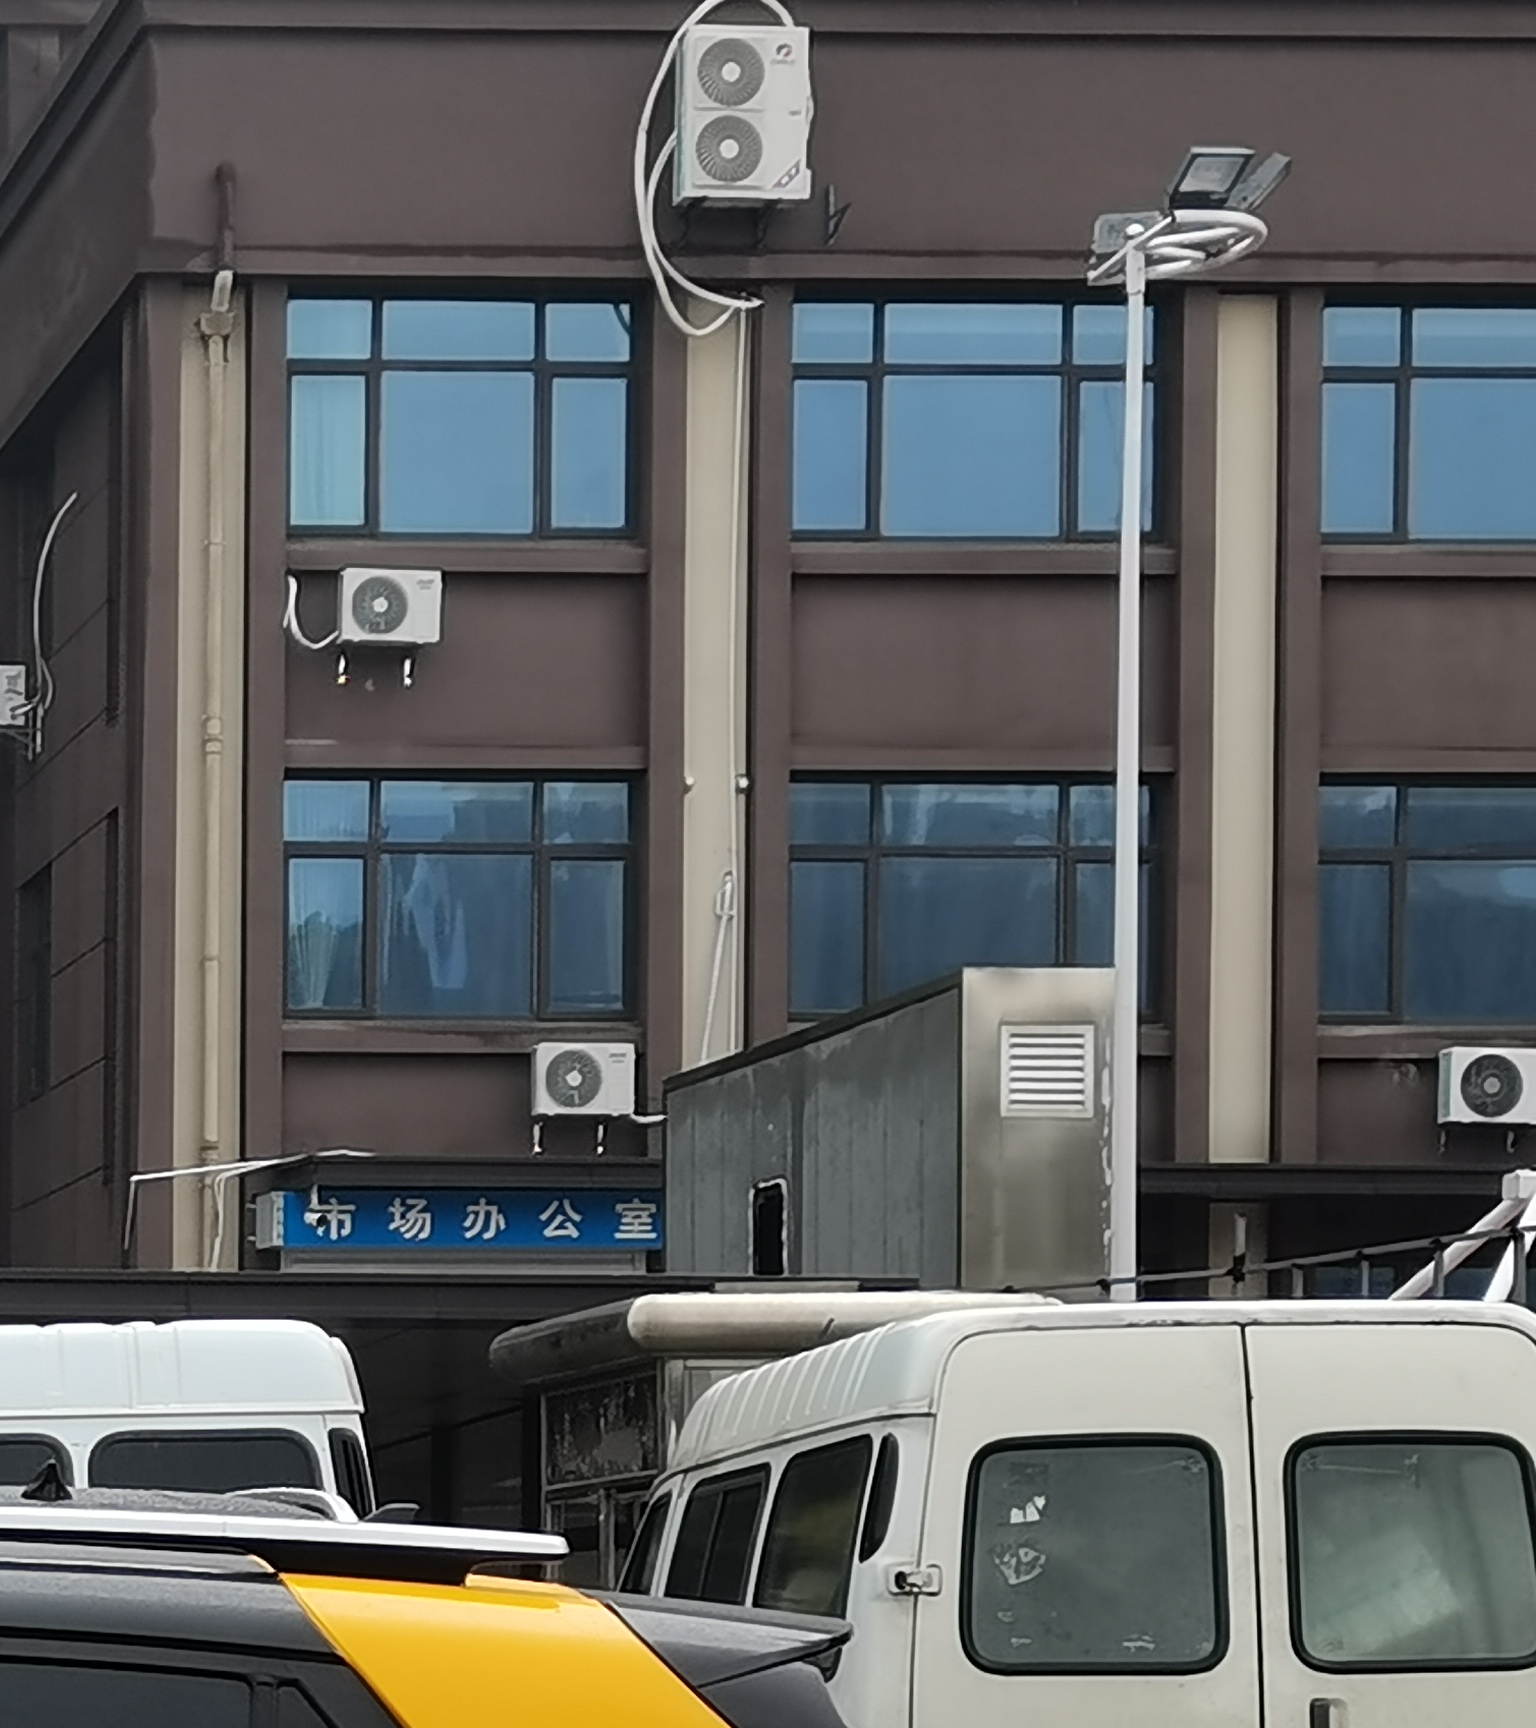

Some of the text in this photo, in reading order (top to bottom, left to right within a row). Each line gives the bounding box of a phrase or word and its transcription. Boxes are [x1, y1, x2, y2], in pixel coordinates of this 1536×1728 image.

[309, 1197, 658, 1241] 市场办公室
